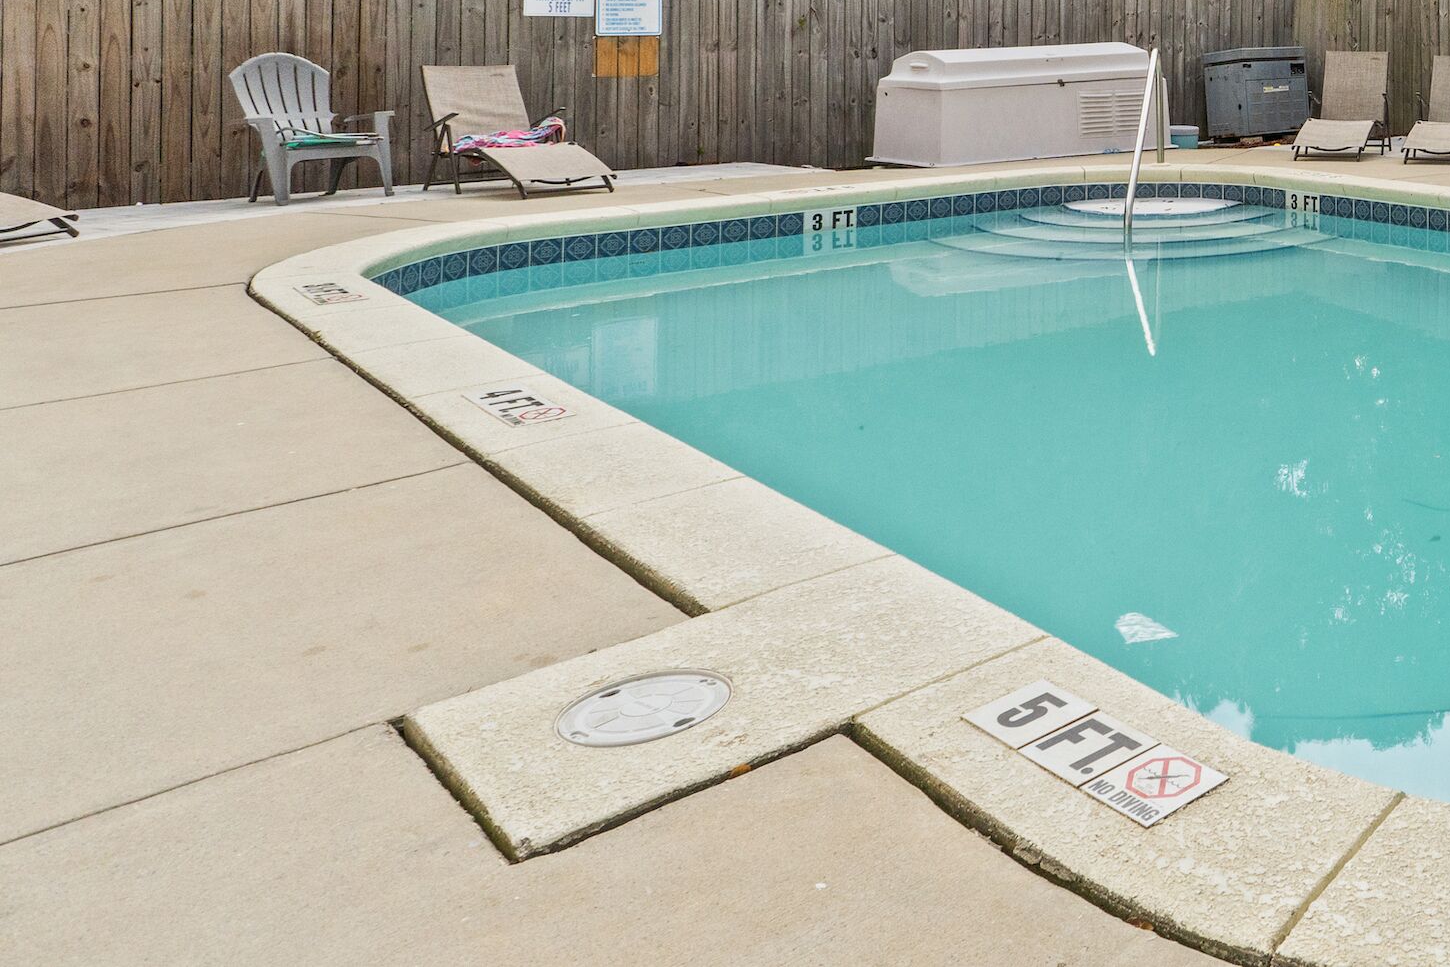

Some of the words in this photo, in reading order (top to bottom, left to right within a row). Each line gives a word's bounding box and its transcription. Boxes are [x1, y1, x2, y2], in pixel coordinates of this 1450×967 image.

[548, 2, 553, 13] 5
[556, 2, 572, 13] FEET
[1291, 194, 1298, 210] 3
[1303, 195, 1318, 213] FT.
[812, 213, 823, 231] 3
[832, 209, 854, 229] FT.
[479, 389, 523, 400] 4
[996, 691, 1069, 728] 5
[1034, 717, 1143, 775] FT.
[1087, 779, 1114, 796] NO
[1107, 790, 1160, 822] DIVING
